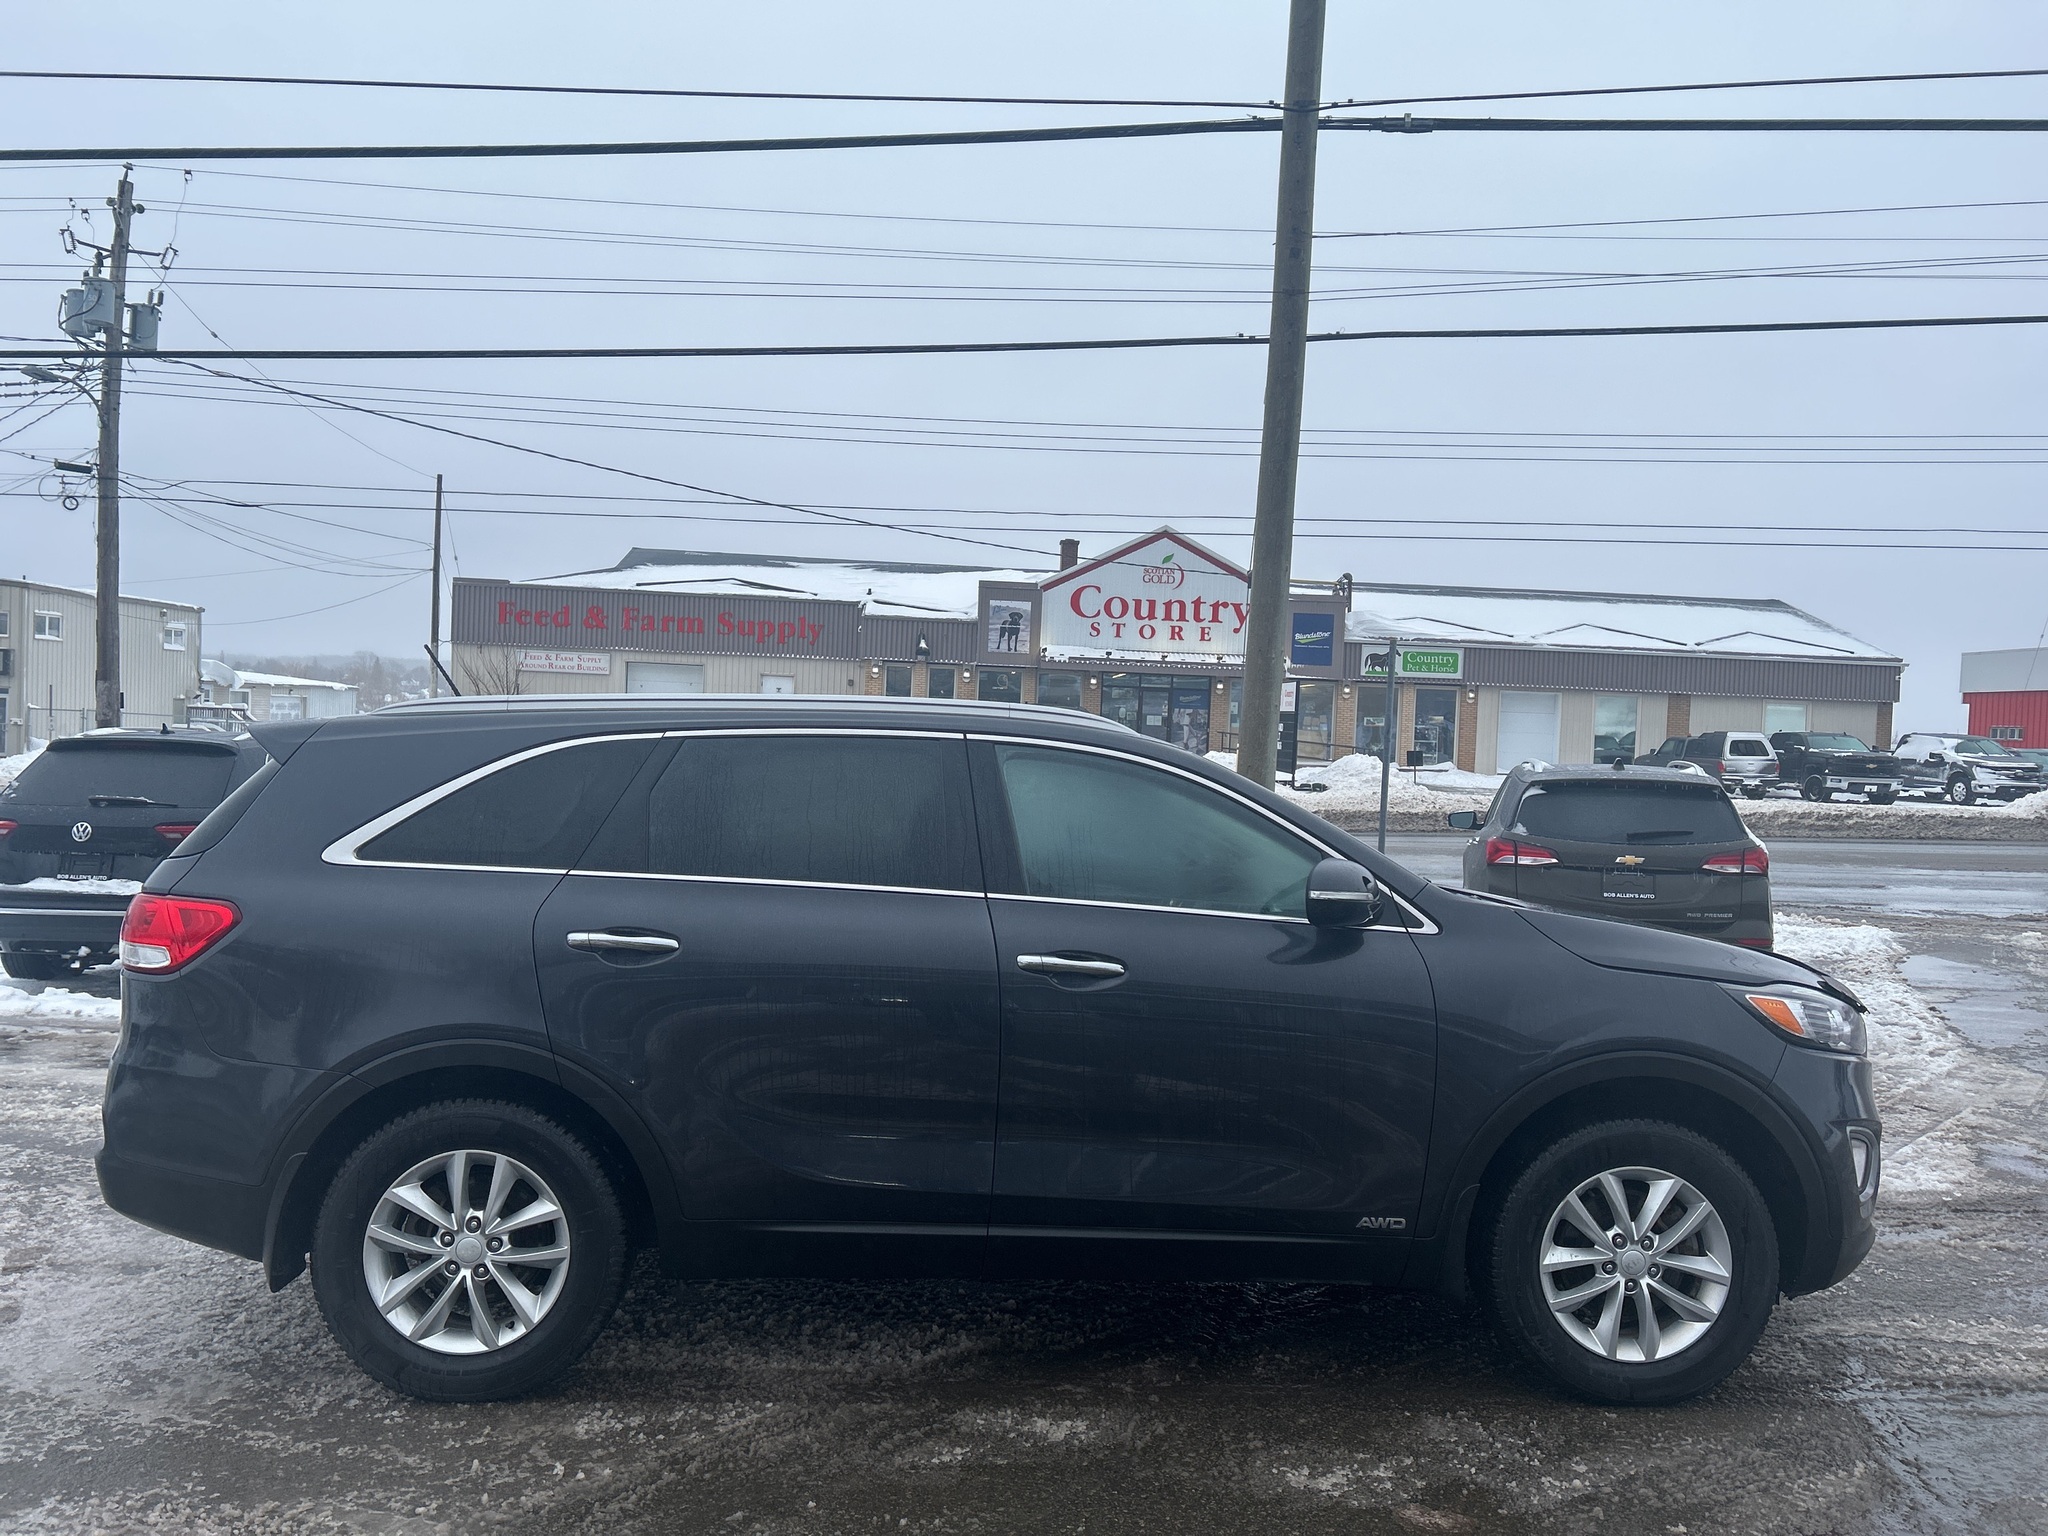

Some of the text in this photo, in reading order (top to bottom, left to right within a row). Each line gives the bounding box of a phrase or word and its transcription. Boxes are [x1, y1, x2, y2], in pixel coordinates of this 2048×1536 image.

[1143, 566, 1175, 575] SCOTIAN
[1142, 574, 1176, 585] GOLD
[1070, 584, 1250, 634] Country
[497, 600, 824, 645] Feed & Farm Supply
[1089, 621, 1212, 642] STORE
[544, 653, 553, 661] &
[555, 653, 574, 662] FARM
[577, 655, 602, 664] SUPPLY
[1407, 651, 1455, 666] Country
[577, 663, 608, 672] BUILDING
[1407, 663, 1454, 673] Pet & Horse
[1355, 1216, 1407, 1229] AWD
